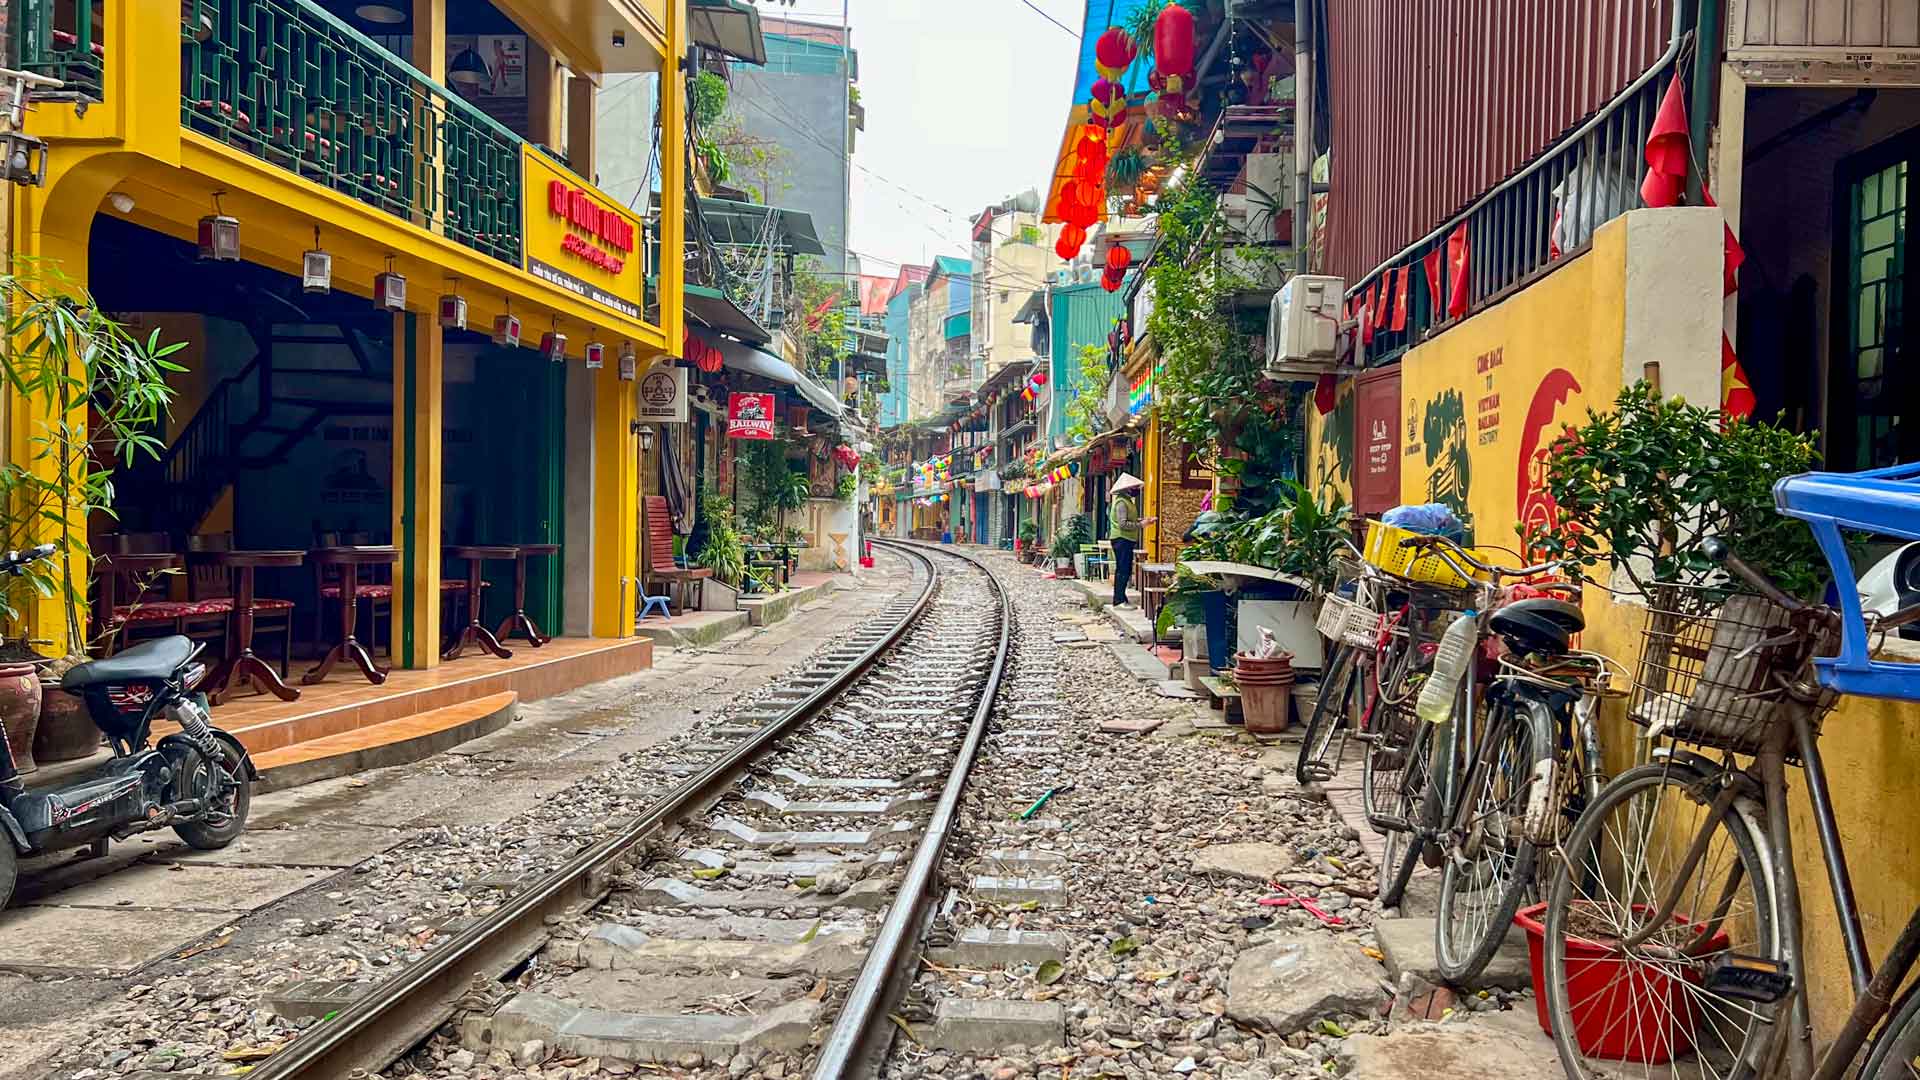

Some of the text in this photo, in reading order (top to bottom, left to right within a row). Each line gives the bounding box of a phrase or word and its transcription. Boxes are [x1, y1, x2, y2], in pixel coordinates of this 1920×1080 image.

[1490, 346, 1503, 368] BACK
[1486, 374, 1493, 392] TO
[1478, 392, 1500, 414] VIETNAM
[730, 418, 772, 431] RAILWAY
